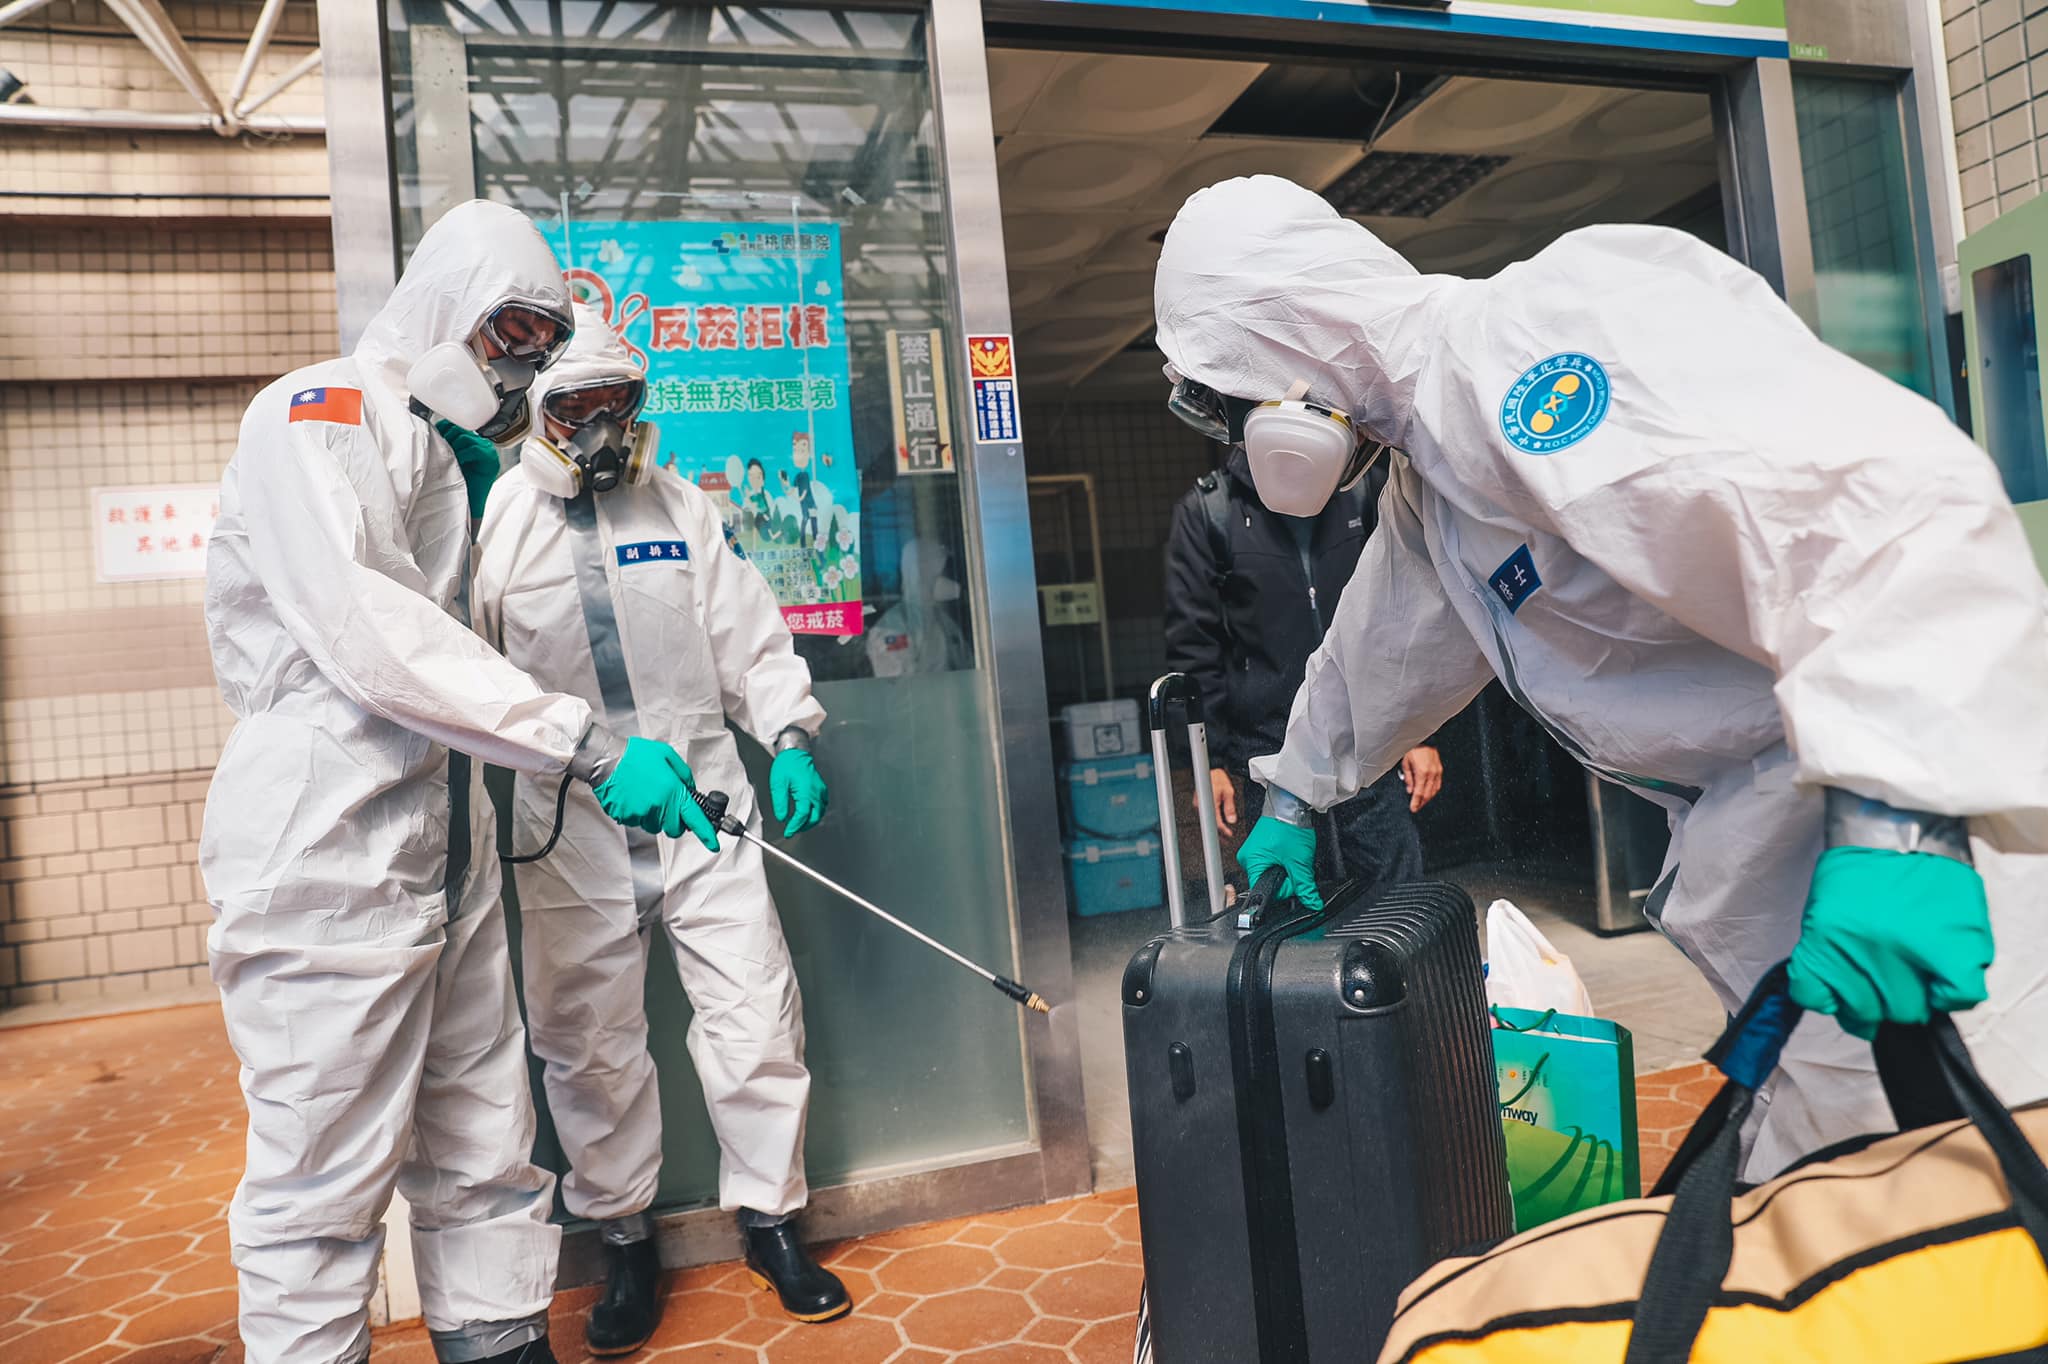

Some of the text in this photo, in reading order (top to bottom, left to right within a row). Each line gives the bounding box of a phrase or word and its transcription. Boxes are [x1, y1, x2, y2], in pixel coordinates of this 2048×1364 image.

[651, 305, 829, 349] 反菸拒檳
[645, 380, 835, 411] 持無菸檳環境
[900, 335, 937, 466] 禁止通行
[786, 610, 844, 630] 您戒菸
